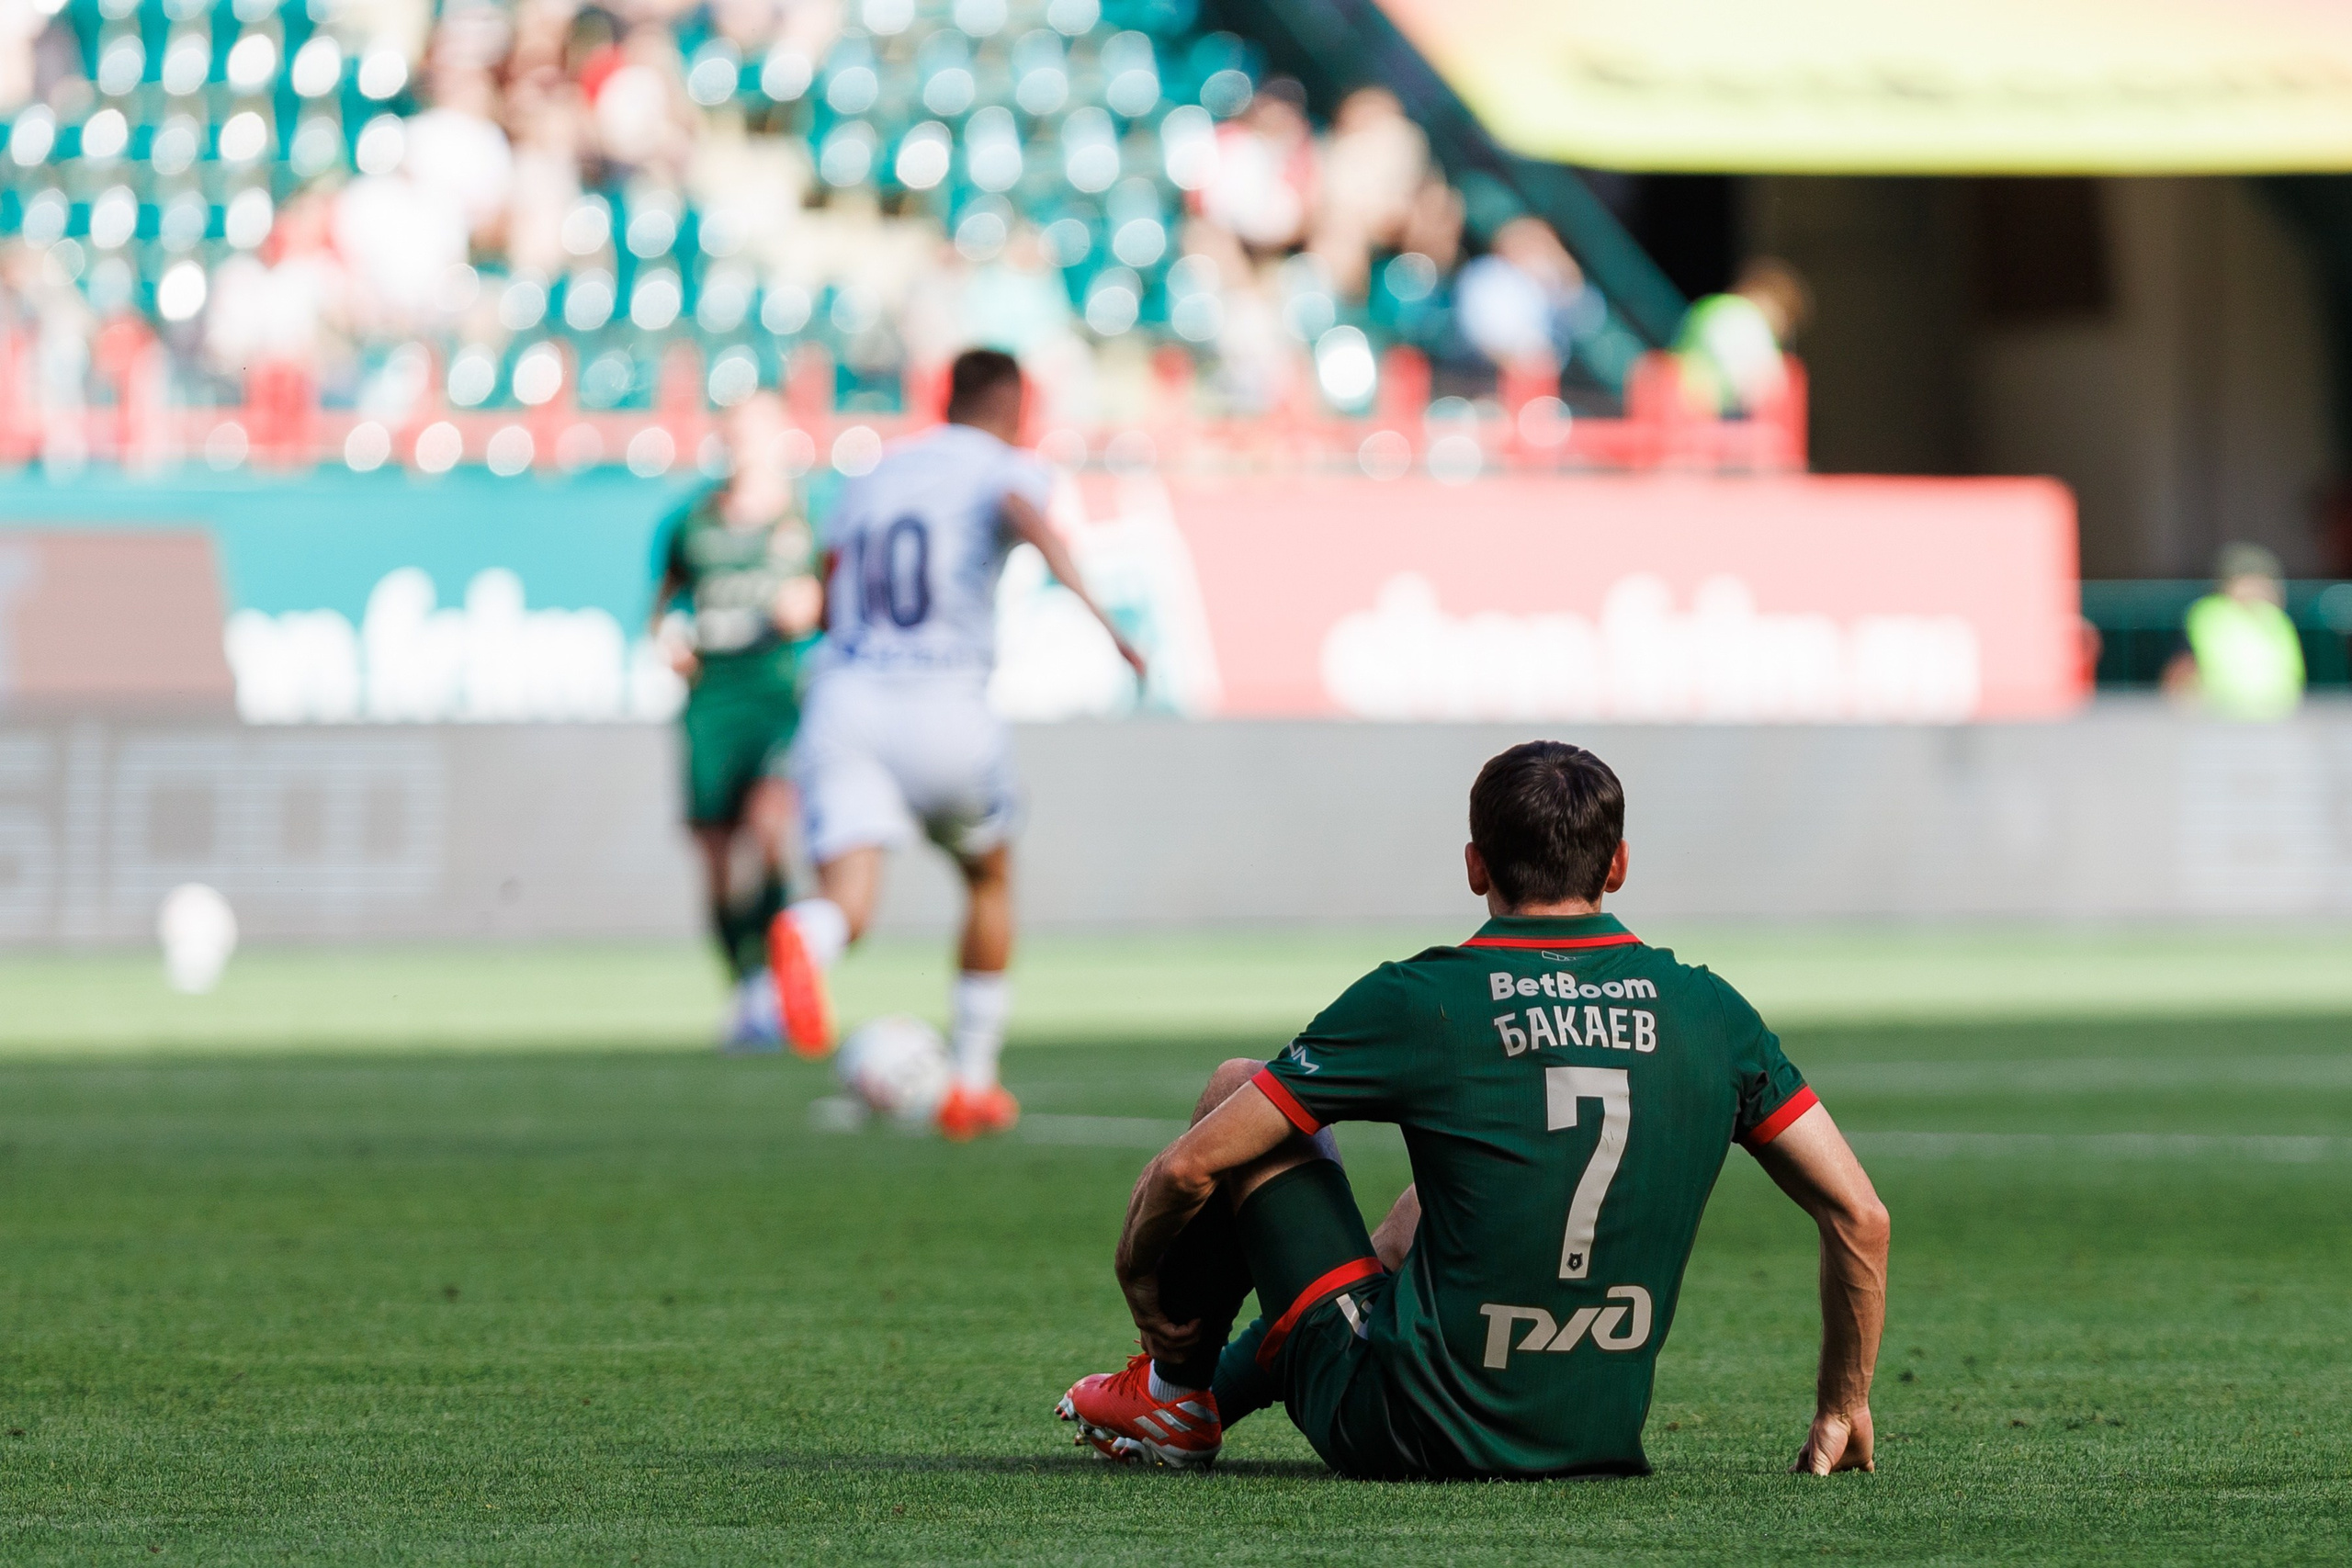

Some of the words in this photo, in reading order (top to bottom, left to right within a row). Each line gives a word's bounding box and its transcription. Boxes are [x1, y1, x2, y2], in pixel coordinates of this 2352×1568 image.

[1489, 971, 1657, 1001] BetBoom
[1494, 1005, 1657, 1057] БАКАЕВ
[1545, 1066, 1632, 1280] 7
